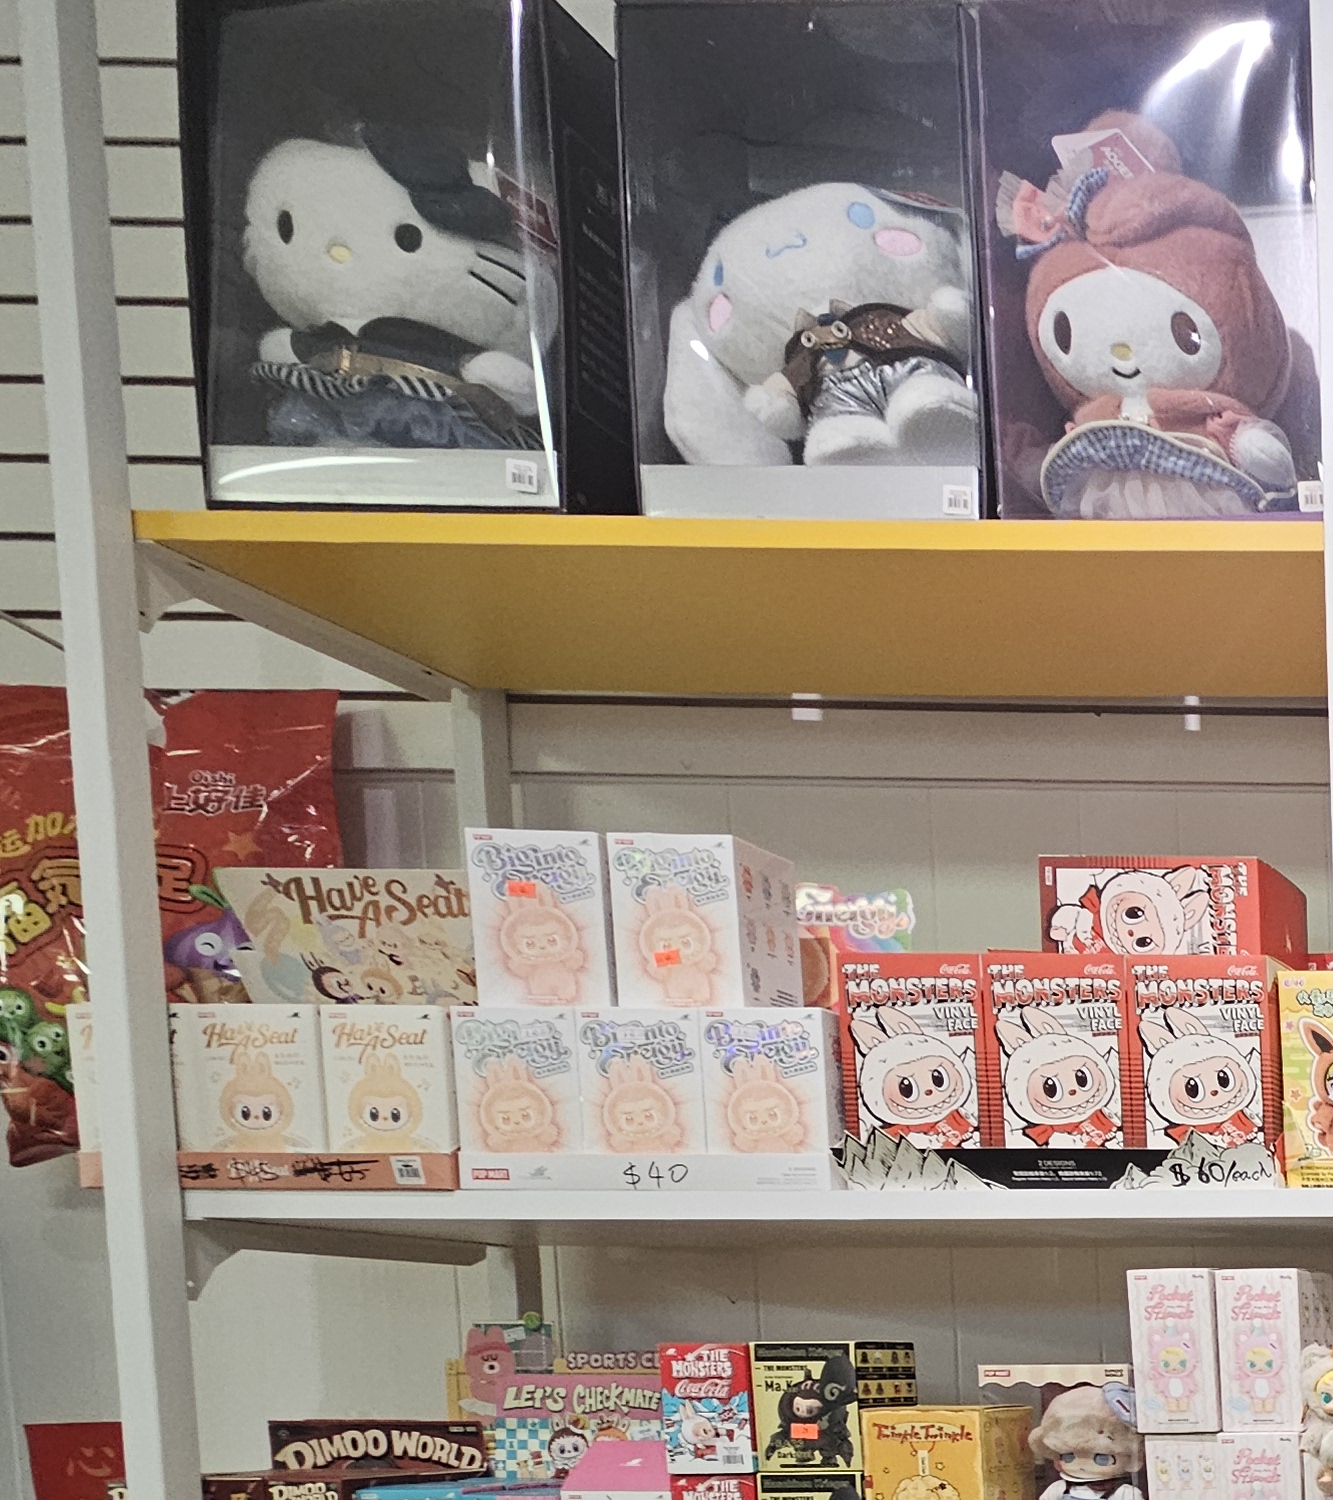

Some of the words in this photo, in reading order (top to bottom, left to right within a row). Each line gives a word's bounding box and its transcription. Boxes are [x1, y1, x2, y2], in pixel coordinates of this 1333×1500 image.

[189, 771, 235, 786] Oishi
[282, 874, 378, 922] Have
[385, 879, 471, 924] Seat
[327, 900, 382, 938] A
[842, 963, 879, 980] THE
[988, 965, 1025, 982] THE
[848, 977, 978, 1008] MONSTERS
[990, 978, 1121, 1008] MONSTERS
[933, 1006, 979, 1020] VINYL
[1076, 1006, 1122, 1020] VINYL
[1219, 1008, 1265, 1021] VINYL
[947, 1018, 979, 1031] FACE
[1090, 1018, 1122, 1031] FACE
[1233, 1019, 1265, 1032] FACE
[1147, 1284, 1194, 1303] Pocket
[1235, 1284, 1281, 1303] Pocket
[566, 1352, 638, 1370] SPORTS
[504, 1387, 567, 1411] LET'S
[572, 1384, 661, 1414] CHECKMATE
[277, 1429, 388, 1472] DIMOO
[392, 1430, 485, 1471] WORLD
